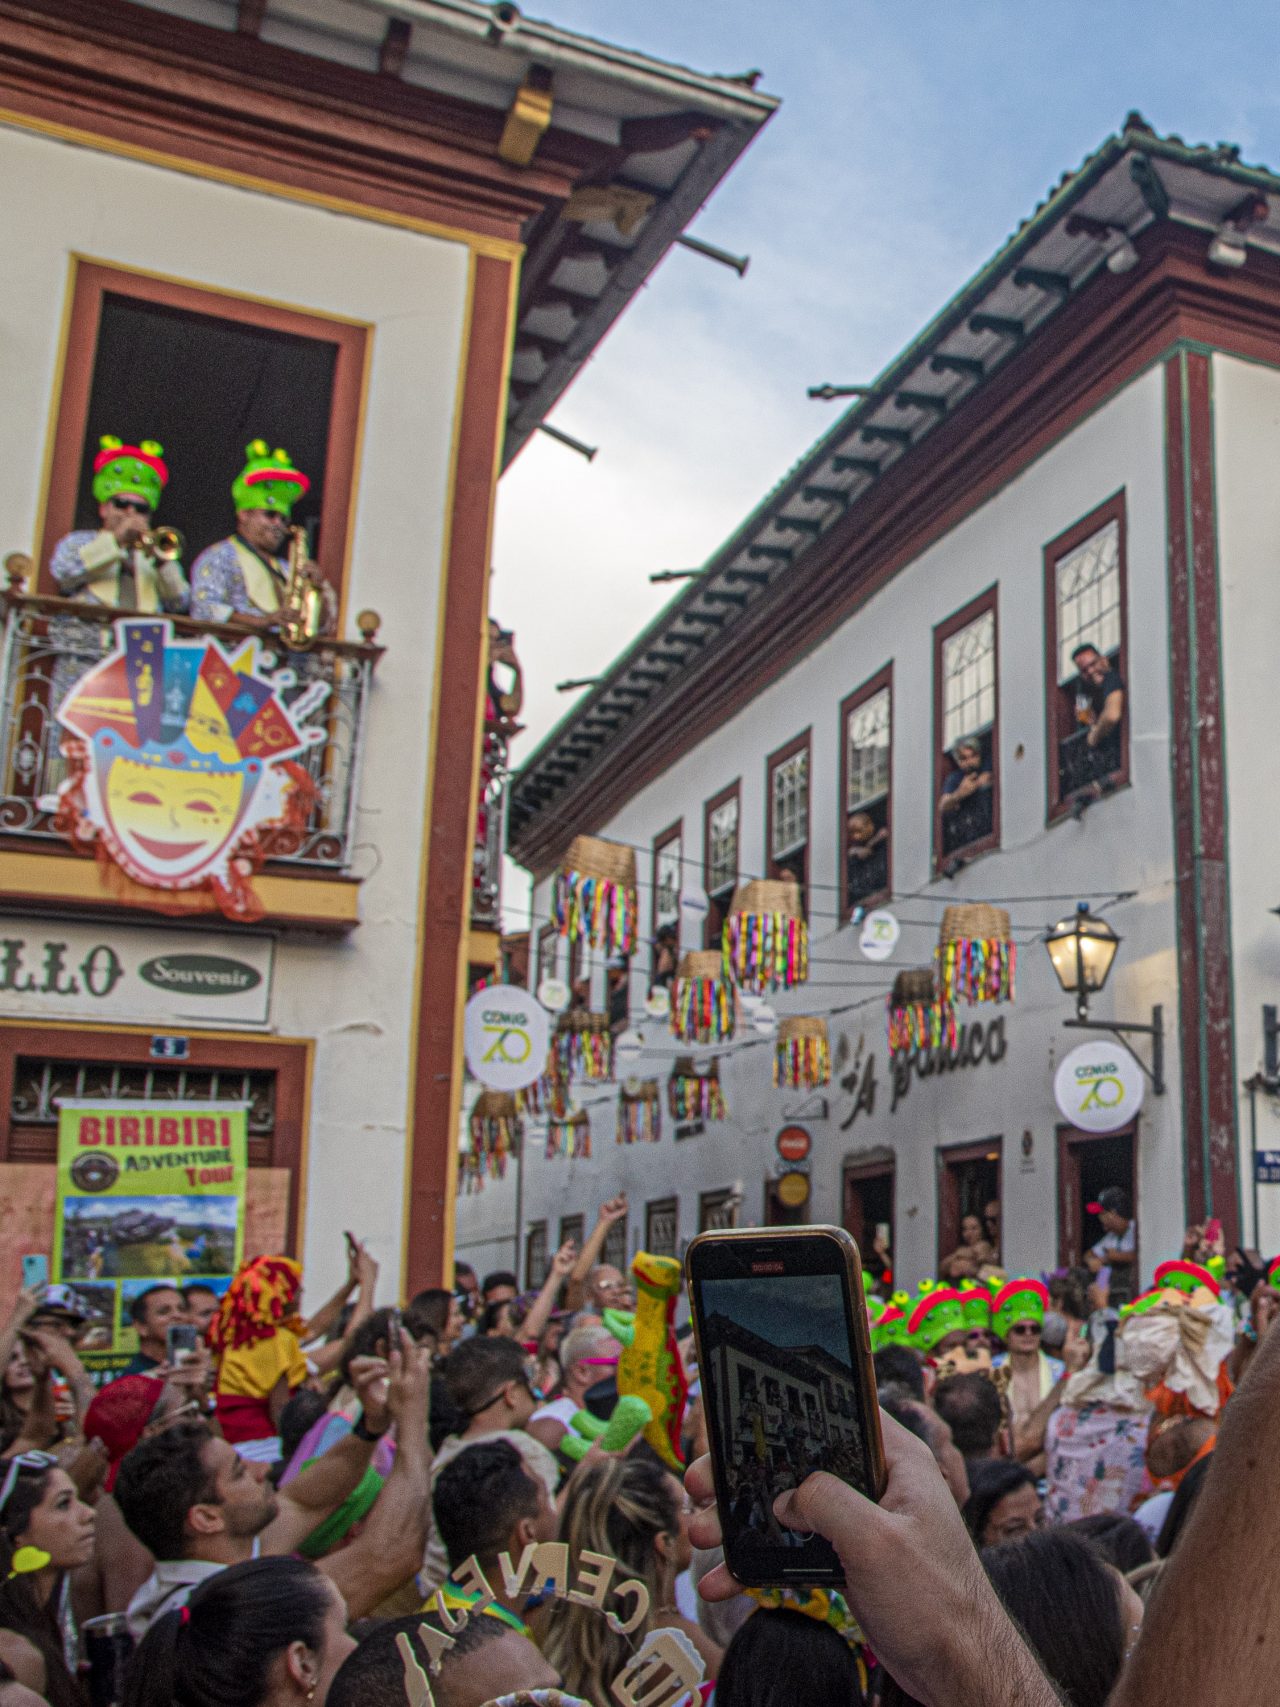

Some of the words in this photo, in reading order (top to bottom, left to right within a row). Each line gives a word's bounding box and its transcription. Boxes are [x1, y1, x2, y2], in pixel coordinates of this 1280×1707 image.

[152, 959, 249, 987] Souvenir
[482, 1026, 532, 1063] 70
[1076, 1076, 1125, 1113] 70
[78, 1116, 231, 1147] BIRIBIRI
[124, 1149, 233, 1173] ADVENTURE
